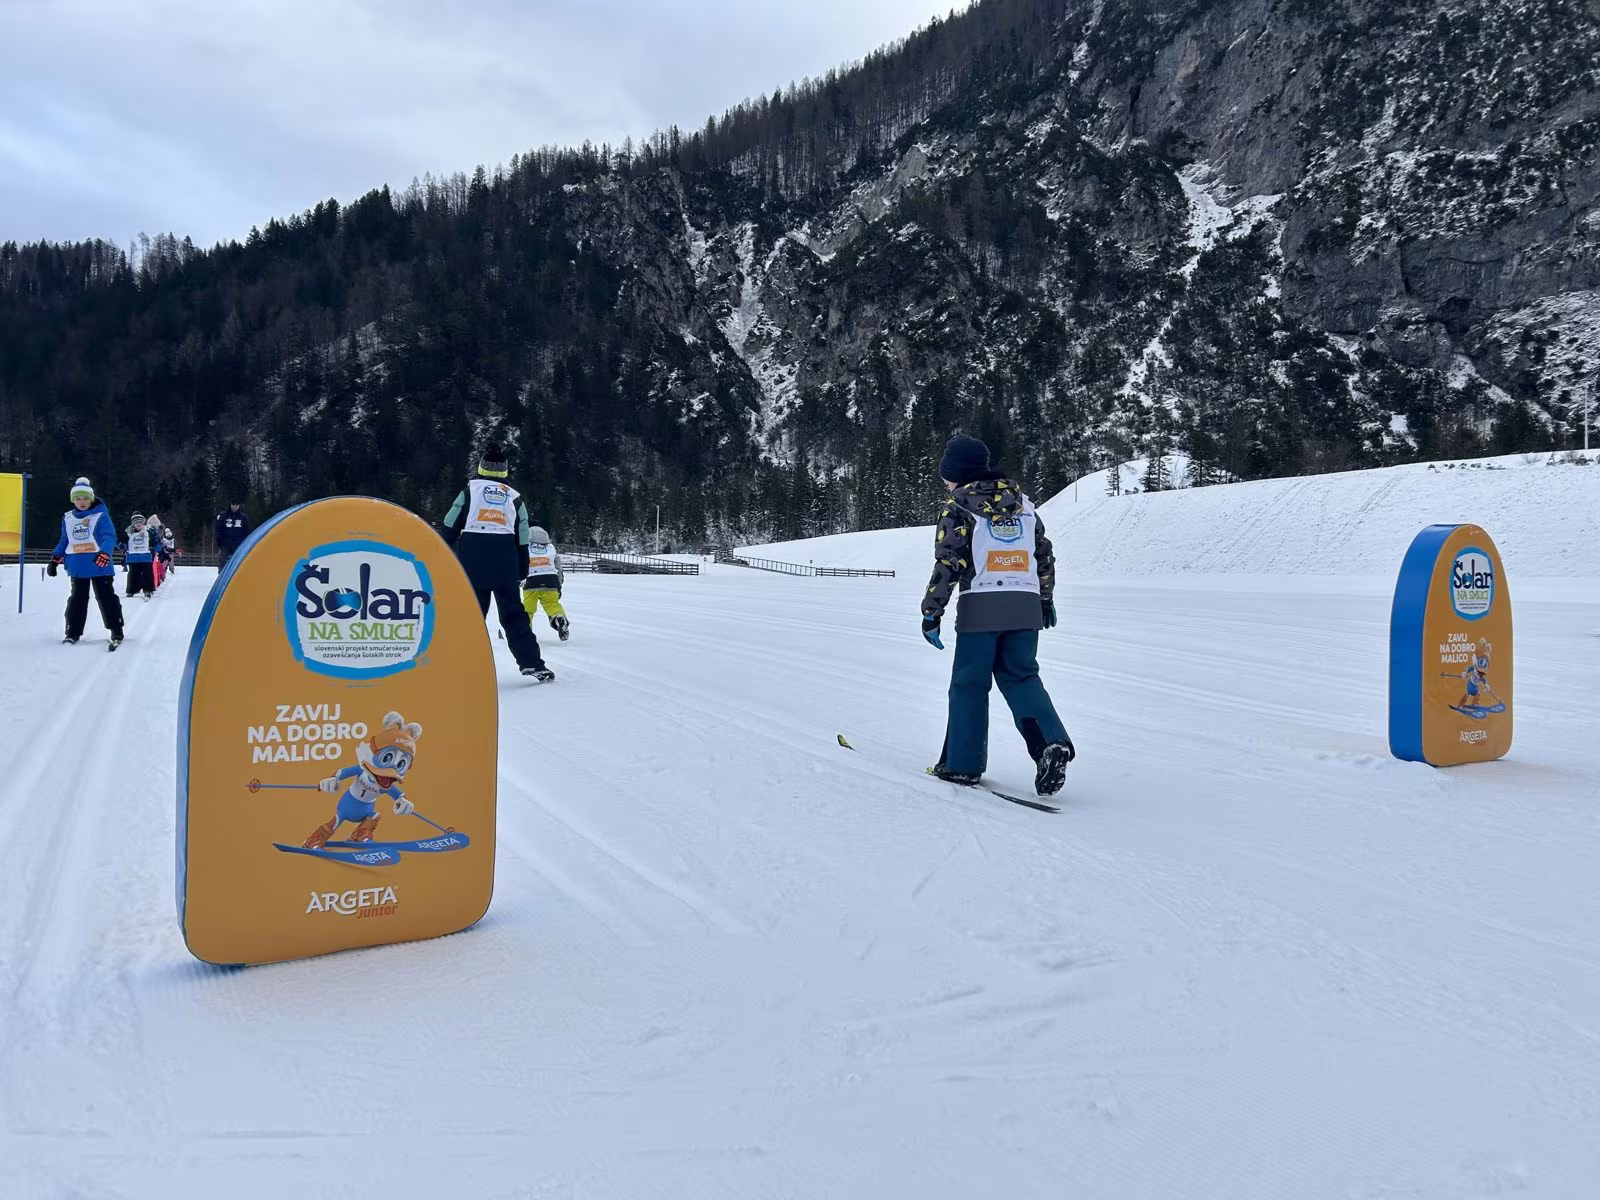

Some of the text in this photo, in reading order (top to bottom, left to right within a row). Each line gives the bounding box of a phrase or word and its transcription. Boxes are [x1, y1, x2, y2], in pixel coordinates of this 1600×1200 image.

[994, 555, 1024, 566] ARGETA
[1454, 559, 1493, 589] Šolar
[295, 564, 431, 620] Šolar
[308, 622, 343, 640] NA
[1448, 633, 1468, 643] ZAVIJ
[345, 645, 368, 653] projekt
[1440, 643, 1476, 653] NA DOBRO
[1441, 653, 1469, 664] MALICO
[275, 703, 341, 722] ZAVIJ
[247, 722, 368, 743] NA DOBRO
[1460, 730, 1487, 744] ARGETA
[252, 742, 342, 763] MALICO
[418, 837, 461, 850] ARGETA
[354, 851, 391, 864] ARGETA
[306, 886, 398, 915] ARGETA
